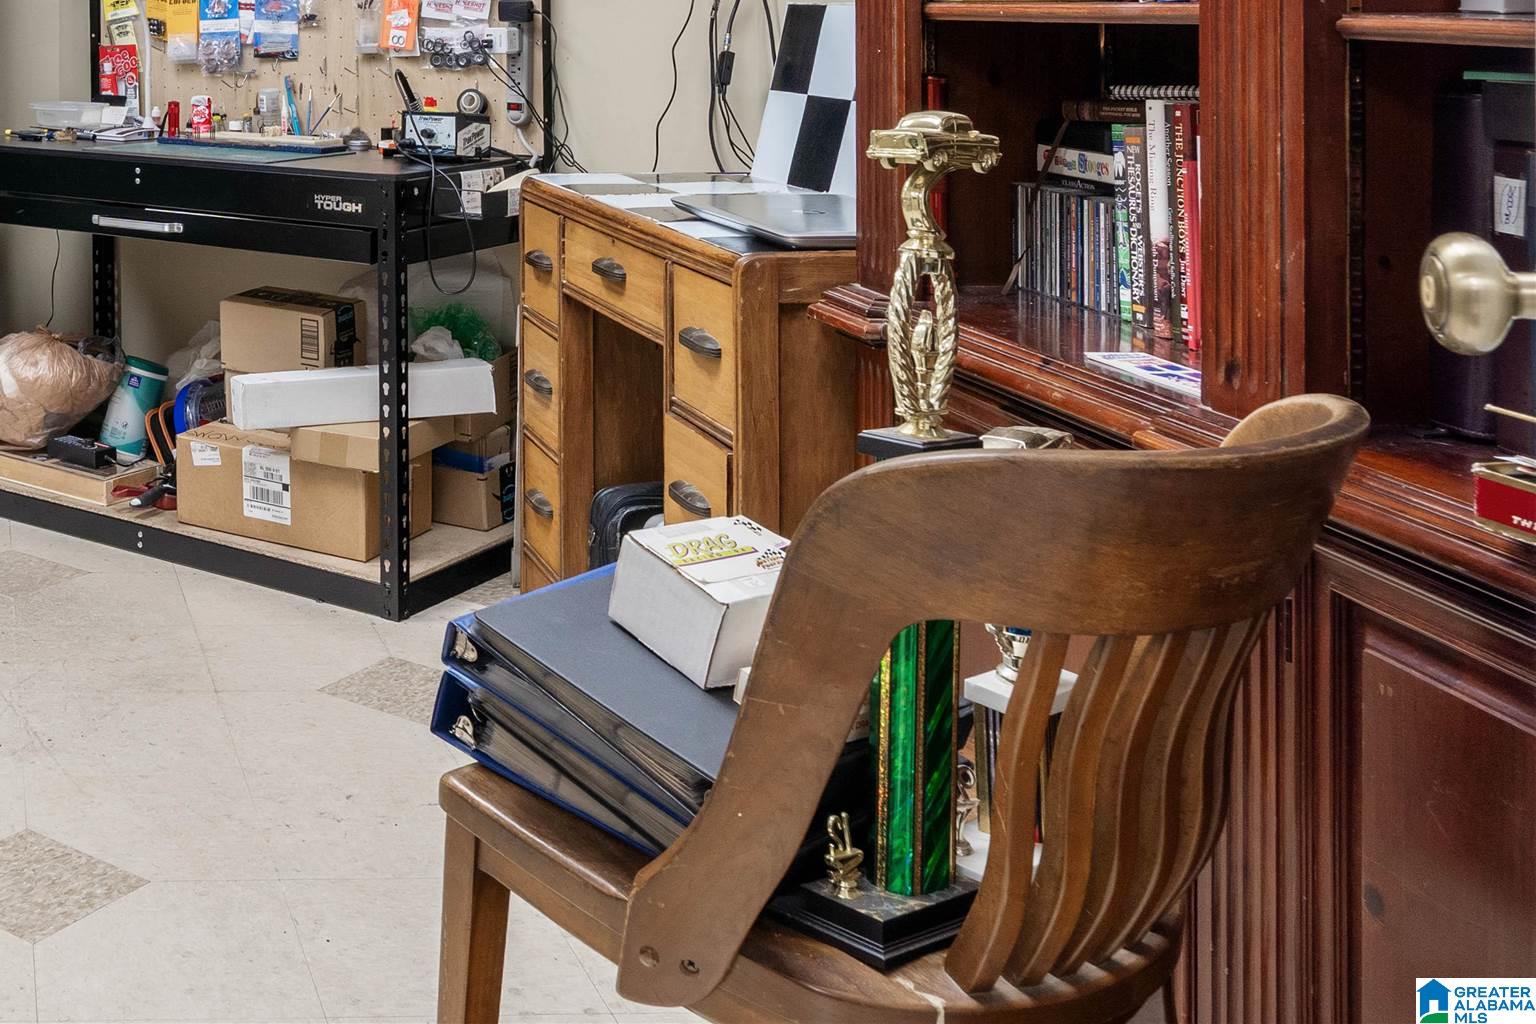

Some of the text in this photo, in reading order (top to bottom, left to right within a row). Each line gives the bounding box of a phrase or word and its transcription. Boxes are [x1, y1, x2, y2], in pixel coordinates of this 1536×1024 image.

[1127, 145, 1140, 154] NEW
[1164, 121, 1172, 157] Another
[1175, 123, 1186, 254] THE JUNCTION BOYS
[314, 200, 362, 213] TOUGH
[1127, 155, 1141, 304] THESAURUS DICTIONARY
[1511, 515, 1536, 531] TH
[667, 533, 737, 559] DRAG
